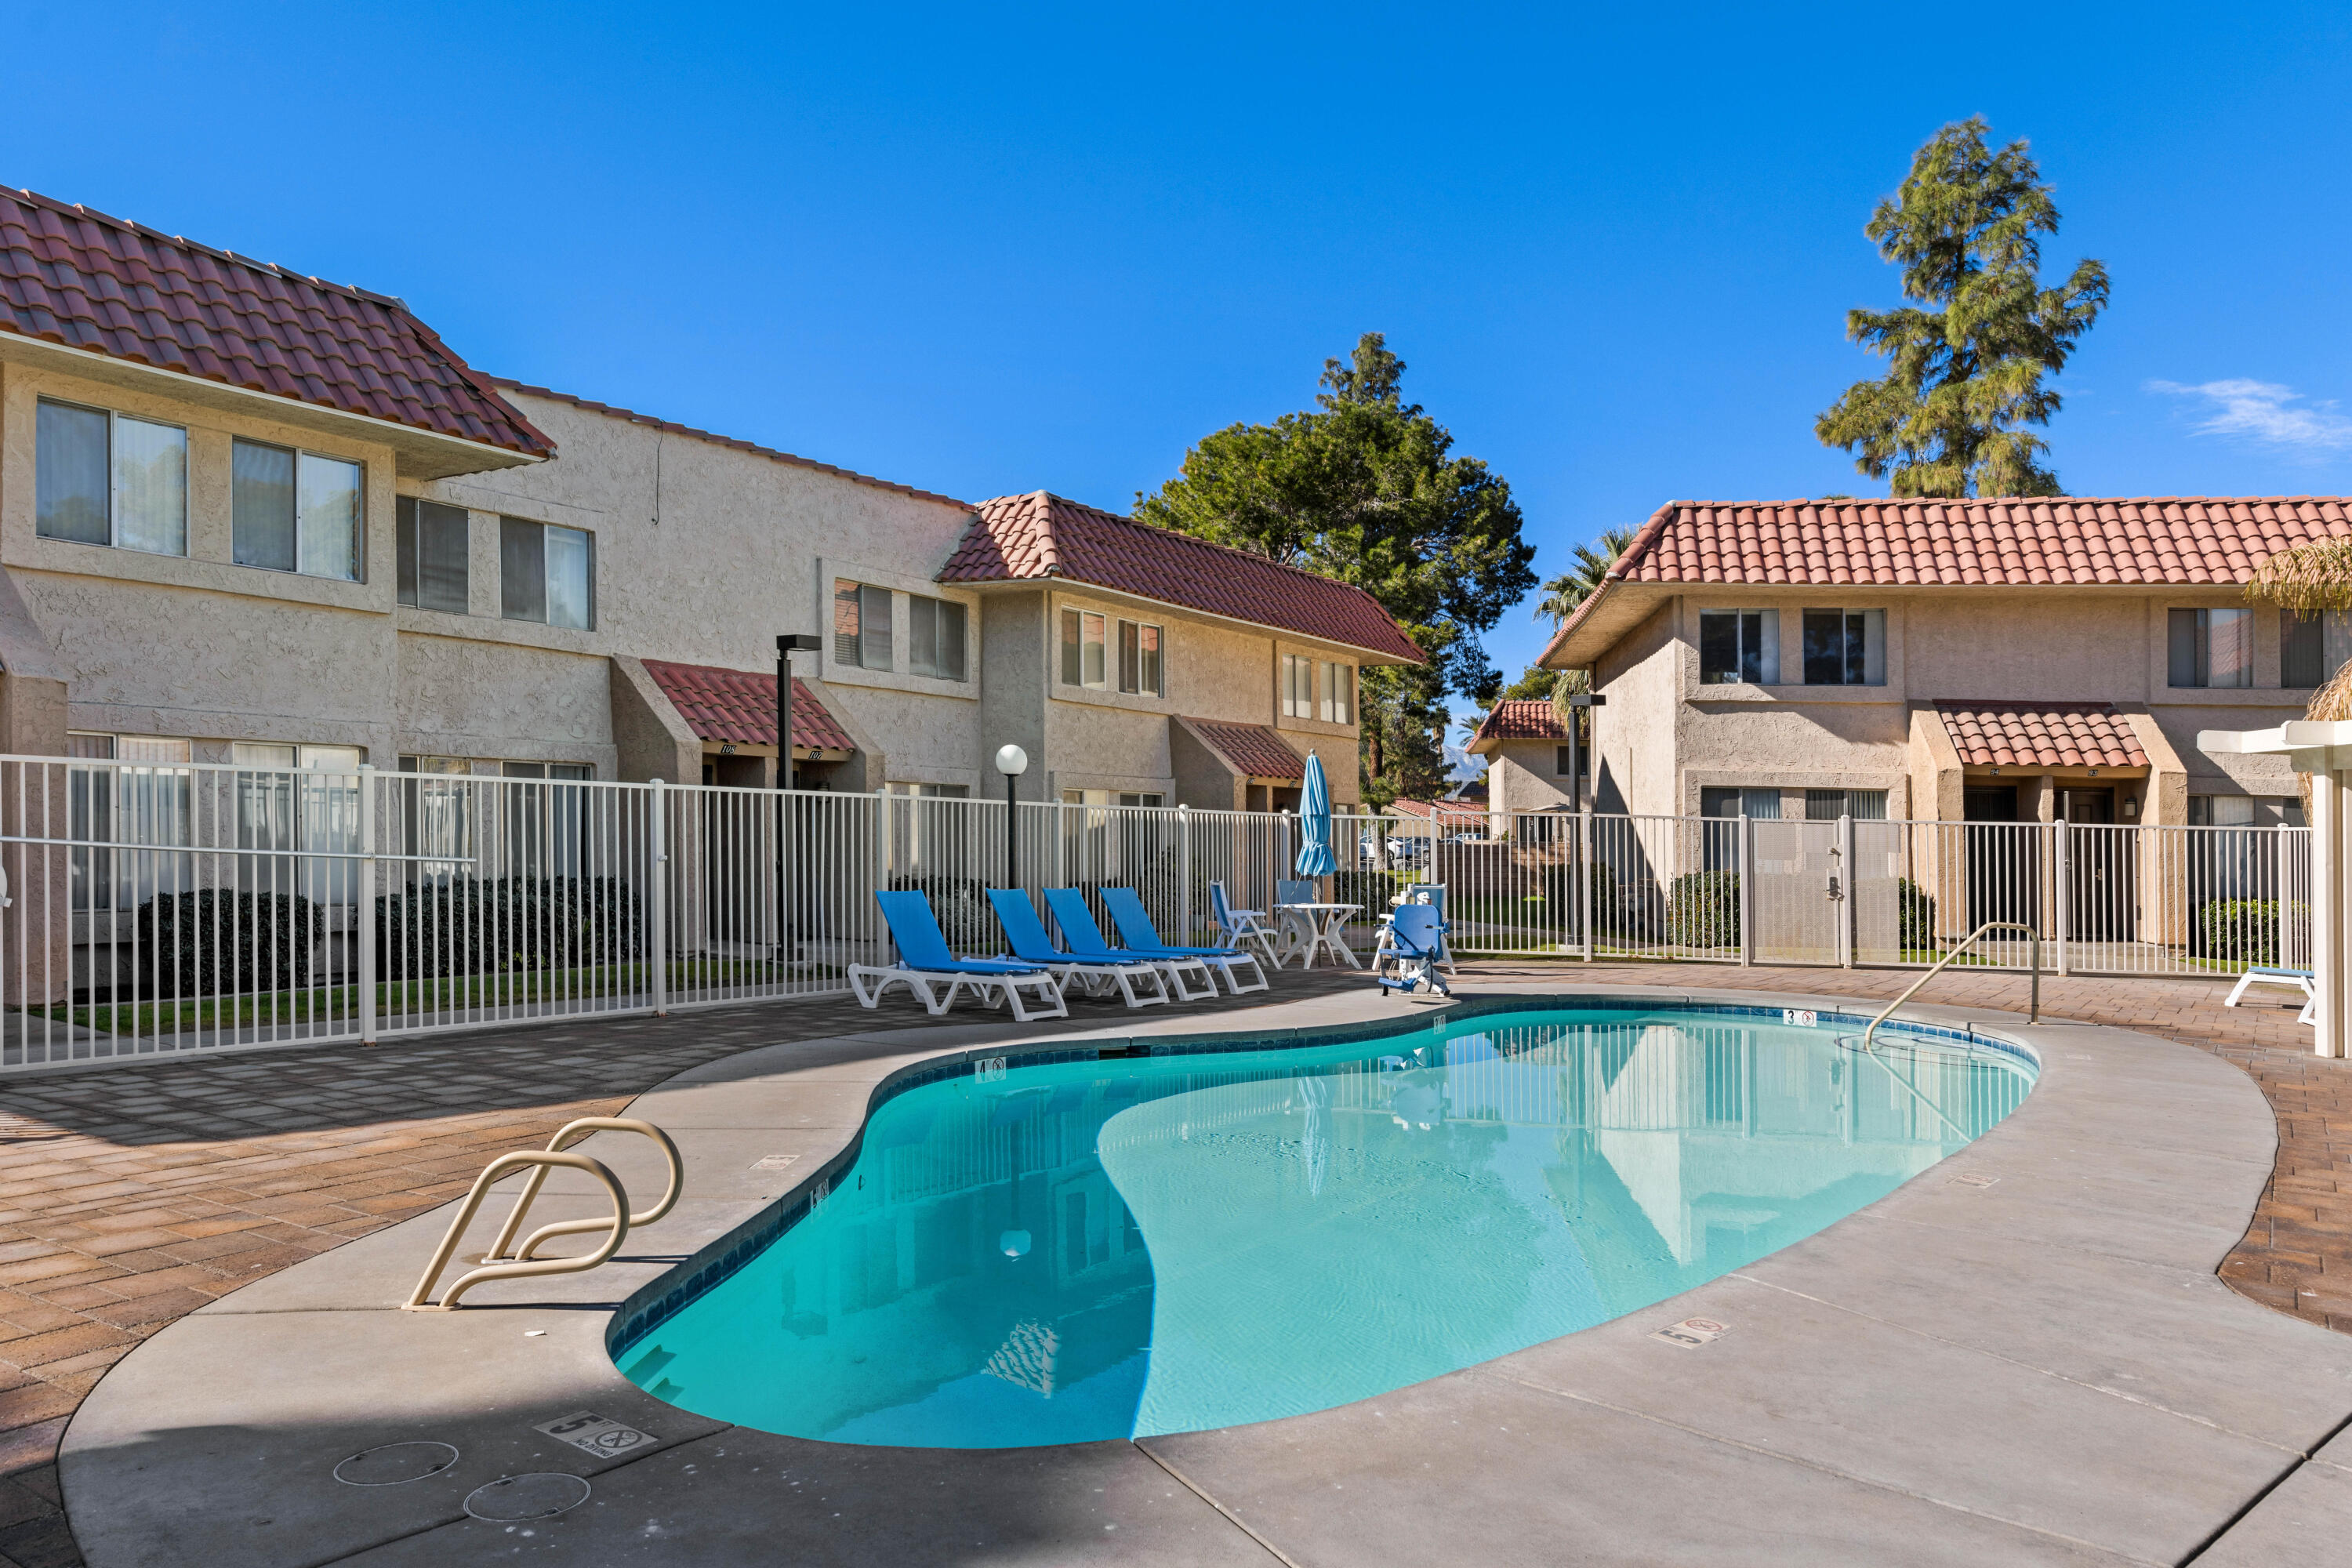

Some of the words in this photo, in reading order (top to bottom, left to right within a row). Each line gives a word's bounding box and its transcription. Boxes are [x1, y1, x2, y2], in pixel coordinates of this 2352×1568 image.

[722, 745, 736, 753] 108
[1788, 1010, 1795, 1024] 3
[1659, 1329, 1702, 1344] 5
[550, 1415, 604, 1434] 5
[575, 1438, 586, 1446] NO
[585, 1443, 614, 1457] DIVING
